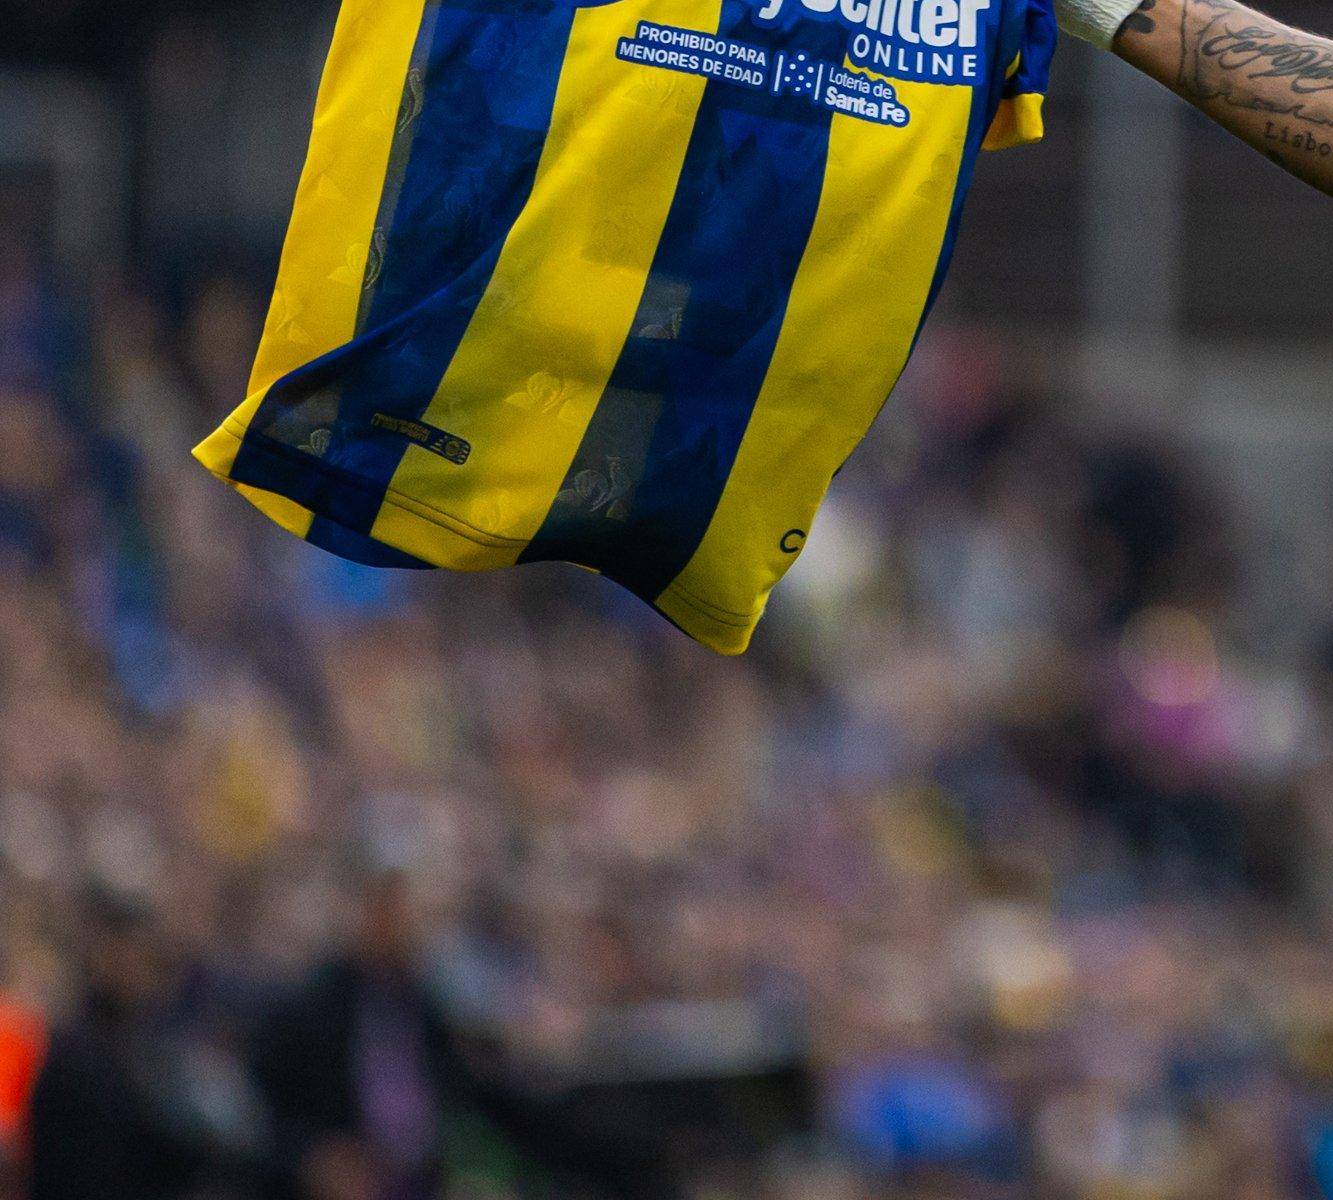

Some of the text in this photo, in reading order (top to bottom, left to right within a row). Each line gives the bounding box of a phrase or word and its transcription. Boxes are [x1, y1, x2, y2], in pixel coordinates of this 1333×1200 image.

[619, 41, 764, 86] MENORES DE EDAD
[638, 25, 766, 67] PROHIBIDO PARA
[852, 33, 977, 77] ONLINE
[828, 66, 893, 100] Lotería de
[824, 85, 907, 124] Santa Fe
